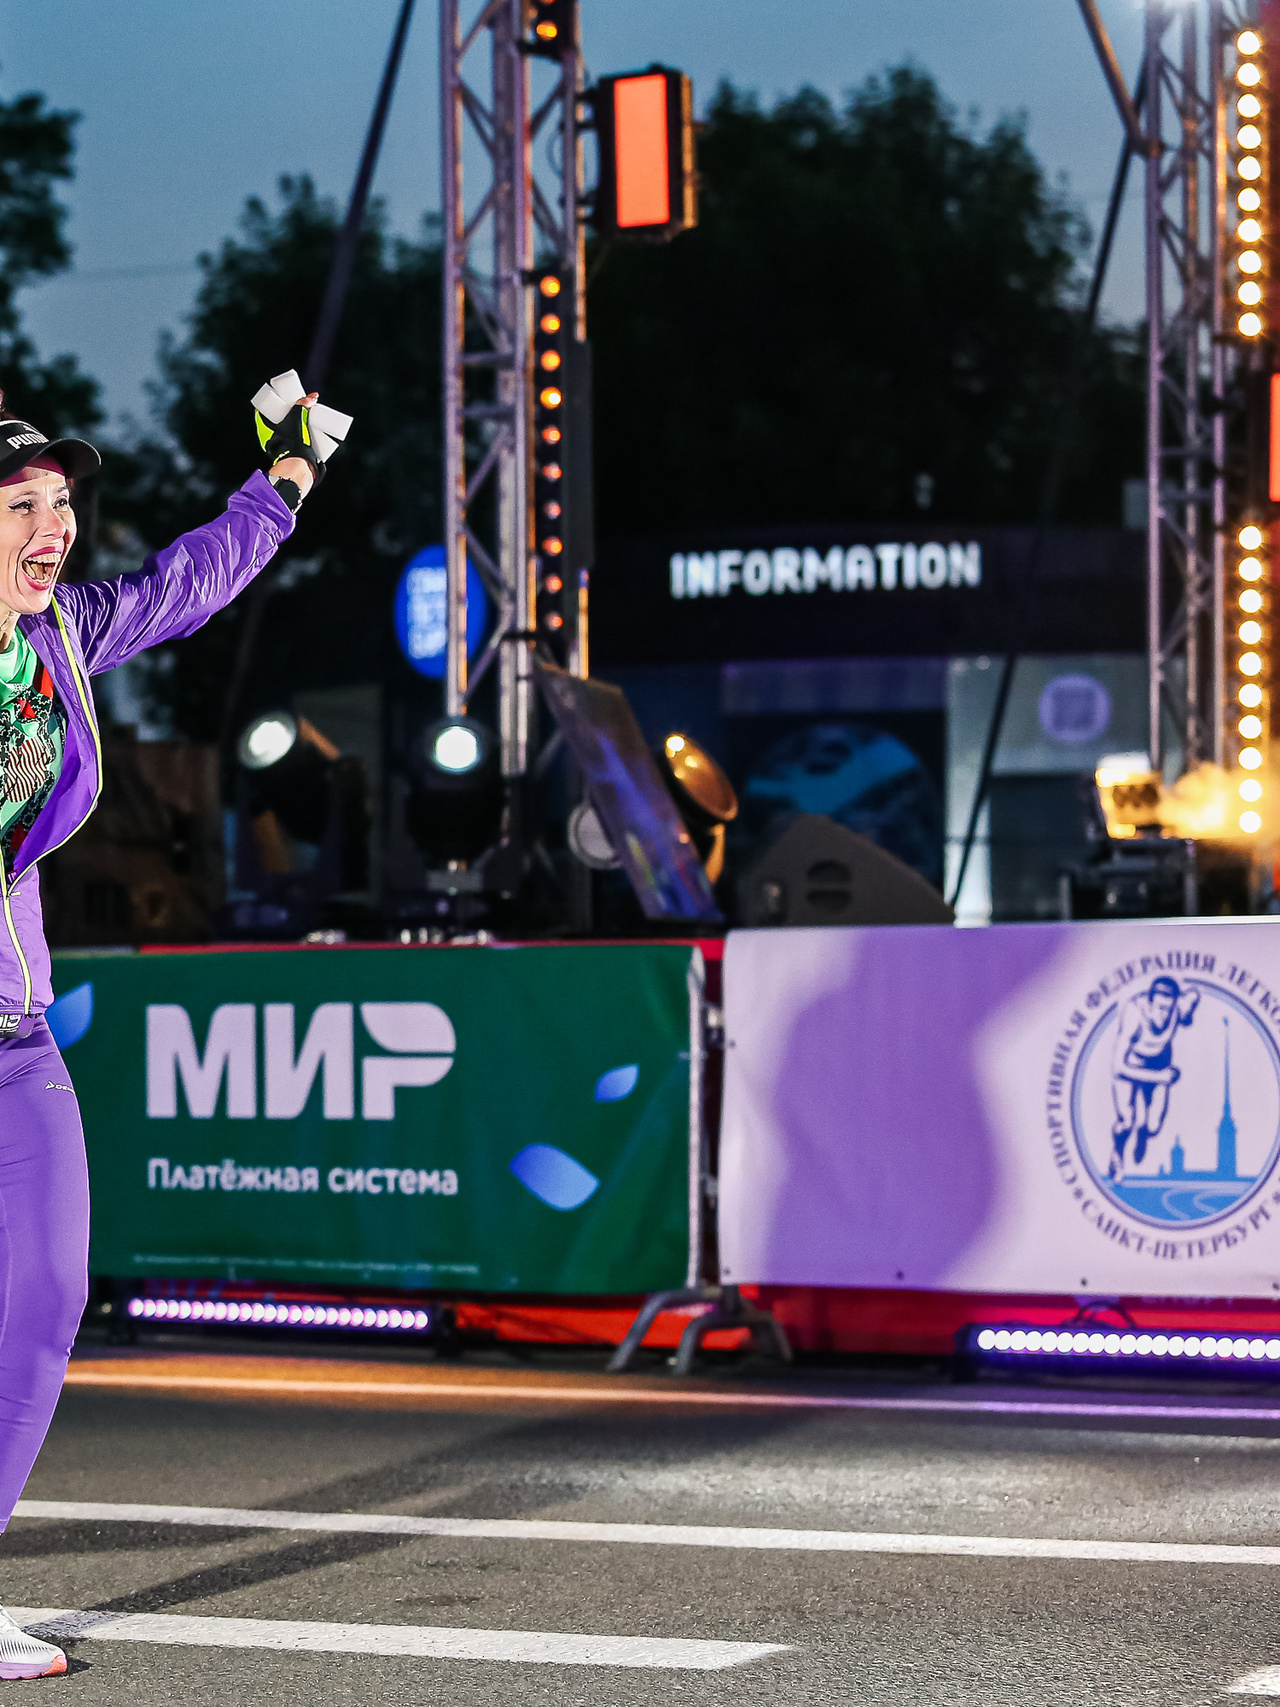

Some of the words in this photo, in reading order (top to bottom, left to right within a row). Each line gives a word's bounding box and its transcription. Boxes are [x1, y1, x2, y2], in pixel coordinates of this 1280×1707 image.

[6, 433, 49, 450] PUMA
[670, 541, 982, 600] INFORMATION
[146, 1001, 457, 1121] МИР
[1046, 1009, 1088, 1186] СПОРТИВНАЯ
[1086, 951, 1217, 1008] ФЕДЕРАЦИЯ
[147, 1157, 320, 1193] Платёжная
[327, 1166, 459, 1196] система
